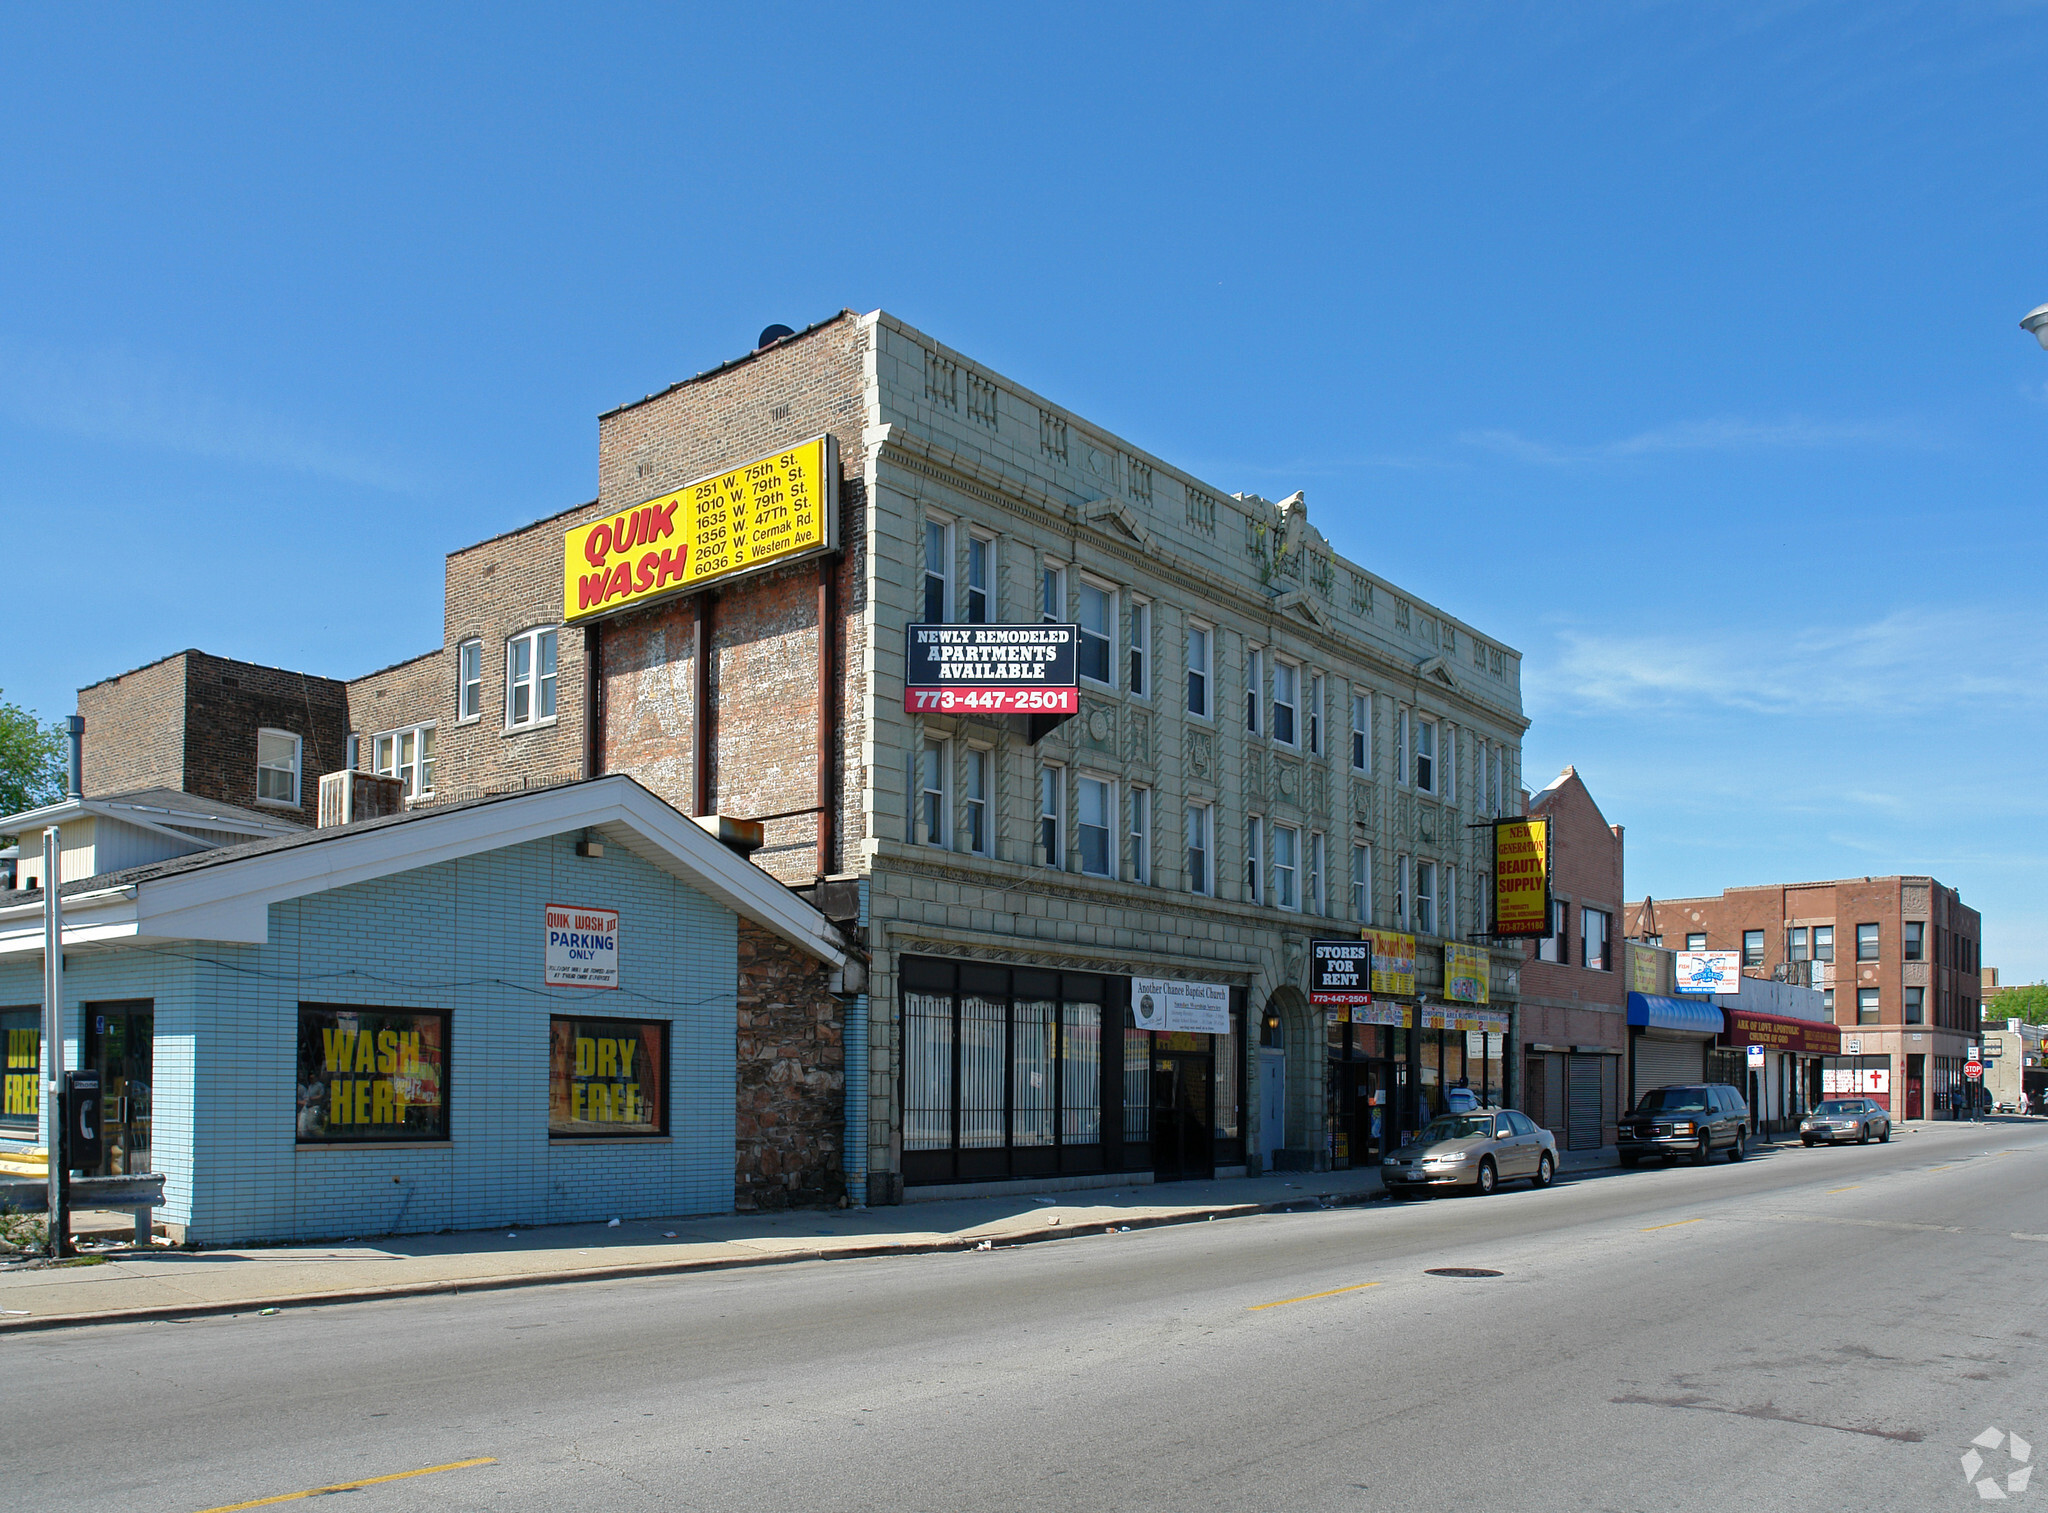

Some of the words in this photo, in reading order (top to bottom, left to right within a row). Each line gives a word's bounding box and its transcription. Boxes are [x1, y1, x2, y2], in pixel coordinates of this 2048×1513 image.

[696, 482, 718, 500] 251
[722, 475, 738, 490] W.
[744, 463, 773, 482] 75th
[780, 453, 798, 469] St.
[696, 496, 724, 514] 1010
[730, 489, 746, 503] W.
[752, 476, 781, 496] 79th
[788, 466, 806, 482] St.
[696, 511, 726, 530] 1635
[733, 504, 749, 518] W.
[754, 489, 784, 510] 79th
[790, 481, 808, 497] St.
[696, 526, 726, 546] 1356
[733, 519, 748, 533] W.
[754, 504, 788, 526] 47Th
[794, 495, 812, 512] St.
[585, 499, 678, 567] QUIK
[696, 543, 726, 561] 2607
[733, 536, 748, 548] W.
[752, 521, 792, 542] Cermak
[796, 512, 814, 528] Rd.
[696, 556, 728, 576] 6036
[735, 551, 744, 563] S
[752, 537, 790, 557] Western
[794, 530, 815, 546] Ave.
[579, 544, 688, 609] WASH
[917, 630, 972, 644] NEWLY
[975, 630, 1070, 644] REMODELED
[927, 646, 1057, 662] APARTMENTS
[938, 663, 1045, 679] AVAILABLE
[914, 691, 1068, 708] 773-447-2501
[1510, 825, 1532, 838] NEW
[1498, 840, 1544, 854] GENERATION
[1498, 858, 1544, 874] BEAUTY
[1498, 876, 1543, 893] SUPPLY
[548, 912, 570, 929] QUIK
[574, 915, 604, 932] WASH
[550, 932, 614, 950] PARKING
[1376, 933, 1400, 957] Discount
[1400, 936, 1414, 960] Store
[569, 949, 596, 960] ONLY
[1316, 946, 1366, 959] STORES
[1327, 960, 1354, 972] FOR
[1322, 973, 1359, 986] RENT
[1138, 982, 1162, 994] Another
[1163, 982, 1184, 995] Chance
[1185, 985, 1205, 999] Baptist
[1206, 987, 1226, 1000] Church
[1313, 995, 1368, 1004] 773-447-2501
[1736, 1019, 1749, 1030] ARK
[1750, 1021, 1758, 1031] OF
[1758, 1022, 1772, 1033] LOVE
[1773, 1024, 1799, 1035] APOSTOLIC
[1749, 1032, 1770, 1042] CHURCH
[1771, 1034, 1777, 1043] OF
[1778, 1035, 1788, 1044] GOD
[8, 1028, 38, 1068] DRY
[322, 1028, 420, 1074] WASH
[576, 1037, 637, 1078] DRY
[4, 1074, 39, 1115] FREE
[571, 1083, 641, 1122] FREE
